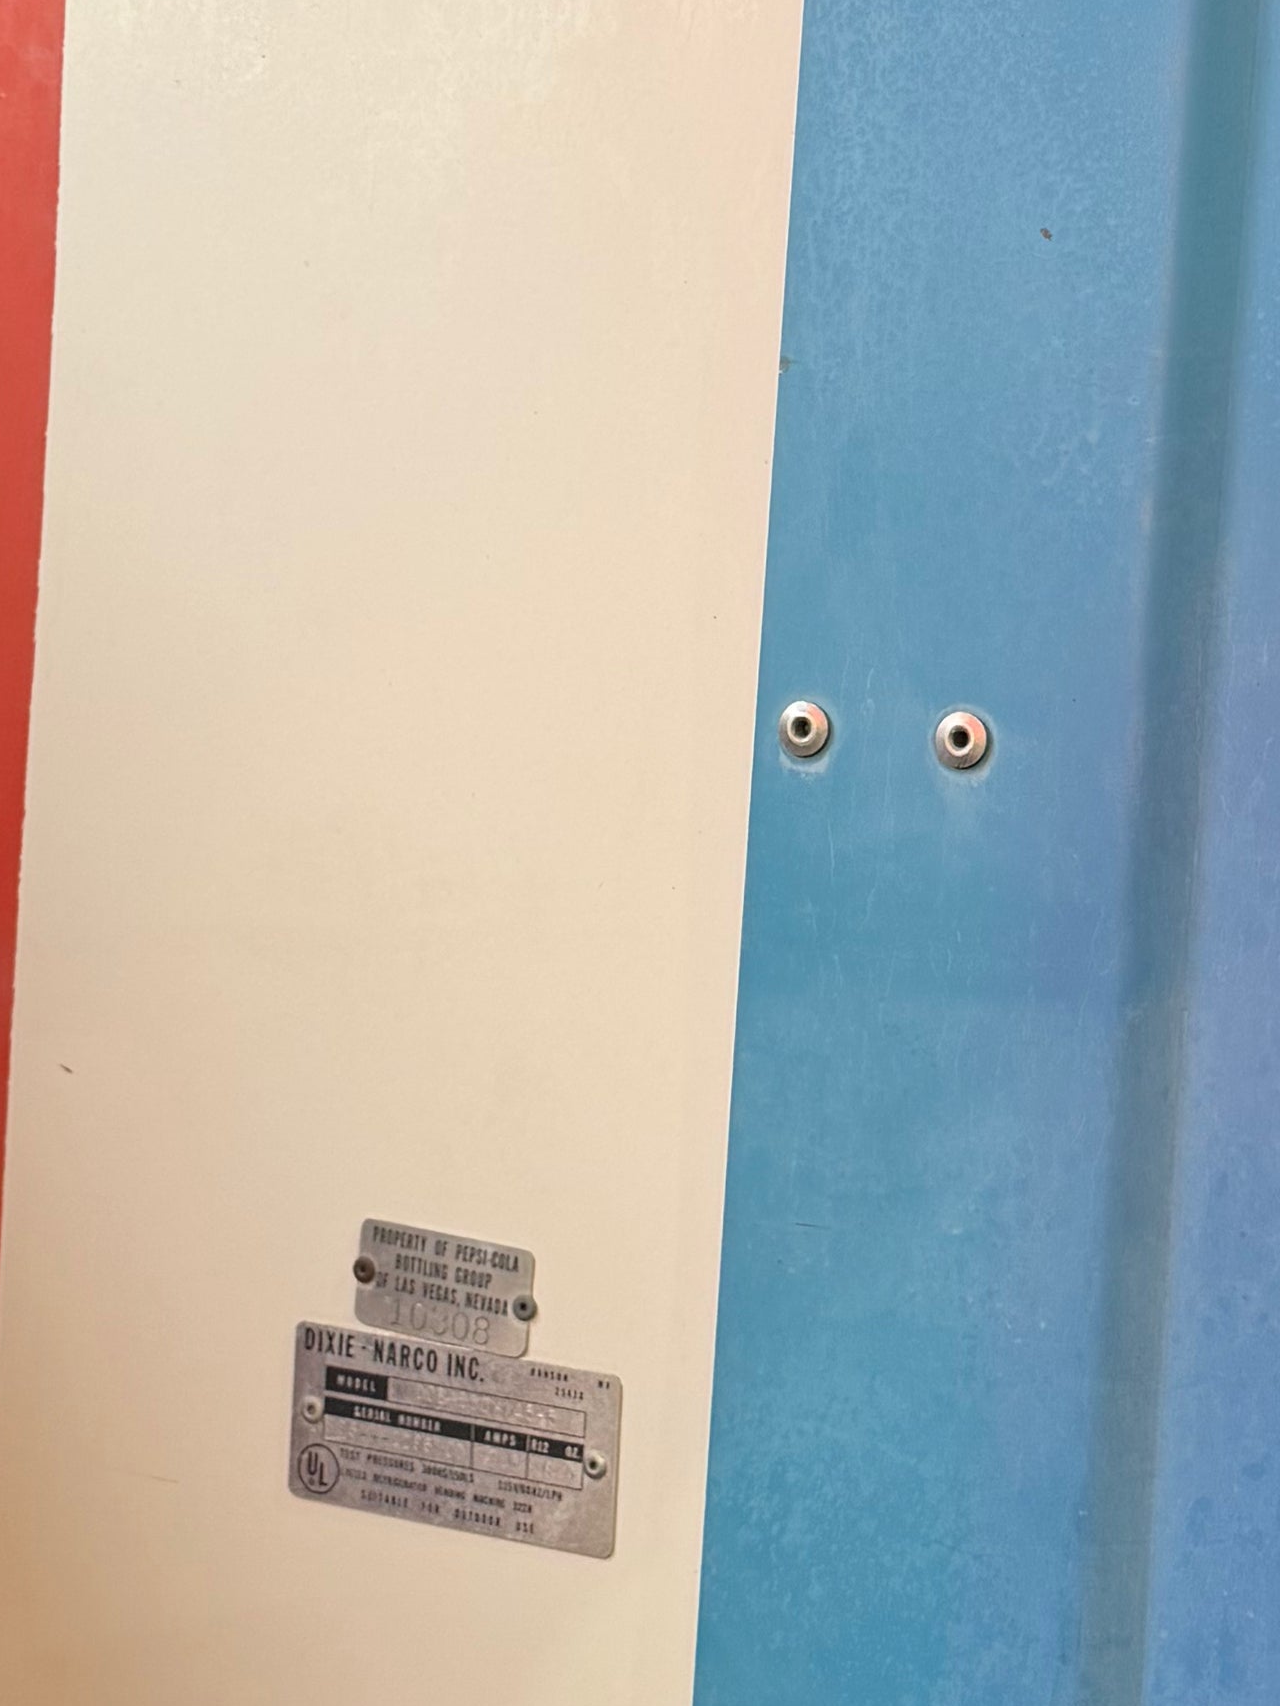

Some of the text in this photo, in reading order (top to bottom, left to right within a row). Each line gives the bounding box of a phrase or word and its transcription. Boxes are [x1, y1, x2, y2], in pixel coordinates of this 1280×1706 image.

[372, 1225, 519, 1273] PROPERTY OF PEPSI-COLA
[395, 1252, 493, 1290] BOTTLING GROUP
[375, 1271, 389, 1288] OF
[395, 1276, 416, 1295] LAS
[465, 1291, 509, 1317] NEVADA
[335, 1374, 377, 1393] MODEL
[447, 1352, 485, 1383] INC.
[483, 1429, 517, 1448] AMPS
